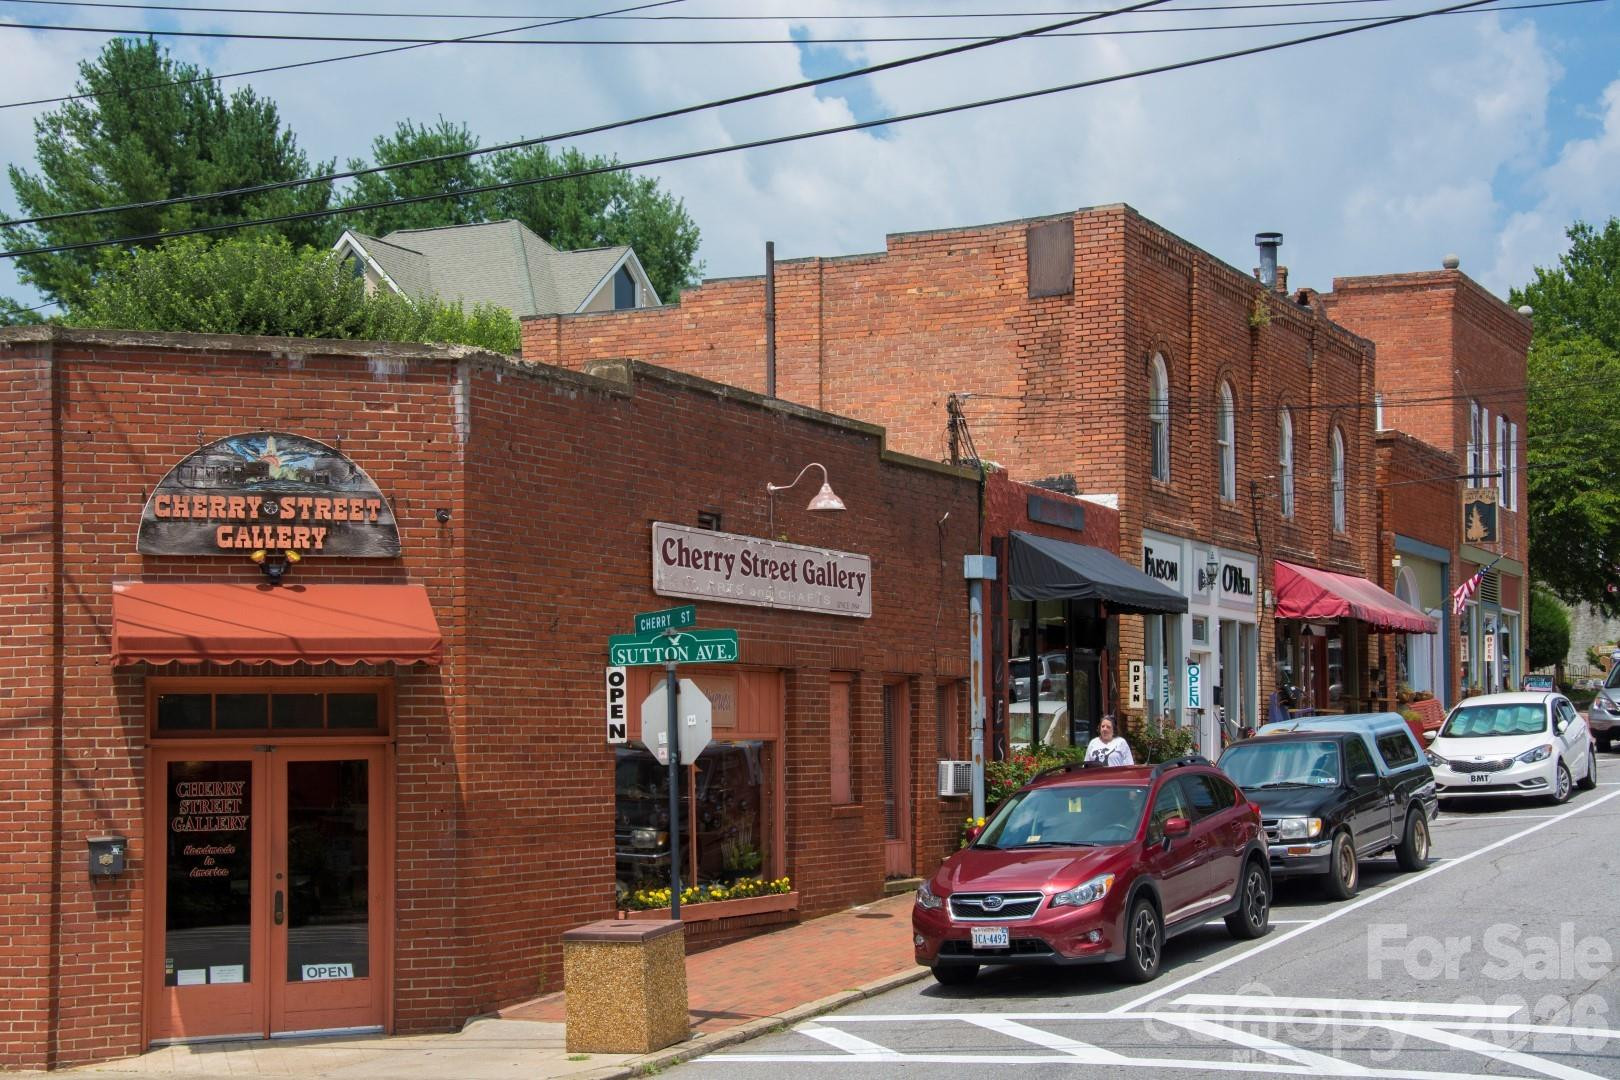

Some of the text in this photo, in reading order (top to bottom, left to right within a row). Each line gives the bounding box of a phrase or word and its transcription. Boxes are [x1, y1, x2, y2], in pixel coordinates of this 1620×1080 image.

[154, 494, 381, 521] CHERRY STREET
[216, 525, 328, 549] GALLERY
[661, 537, 866, 597] Cherry Street Gallery
[640, 610, 691, 631] CHERRY ST
[617, 643, 732, 665] SUTTON AVE.
[1133, 664, 1141, 703] OPEN
[1187, 666, 1200, 707] OPEN
[608, 671, 626, 739] OPEN
[1470, 774, 1489, 783] BMT
[176, 781, 246, 798] CHERRY
[179, 798, 243, 815] STREET
[171, 815, 250, 832] GALLERY
[183, 844, 236, 856] Handmade
[189, 867, 229, 878] America
[306, 966, 348, 980] OPEN
